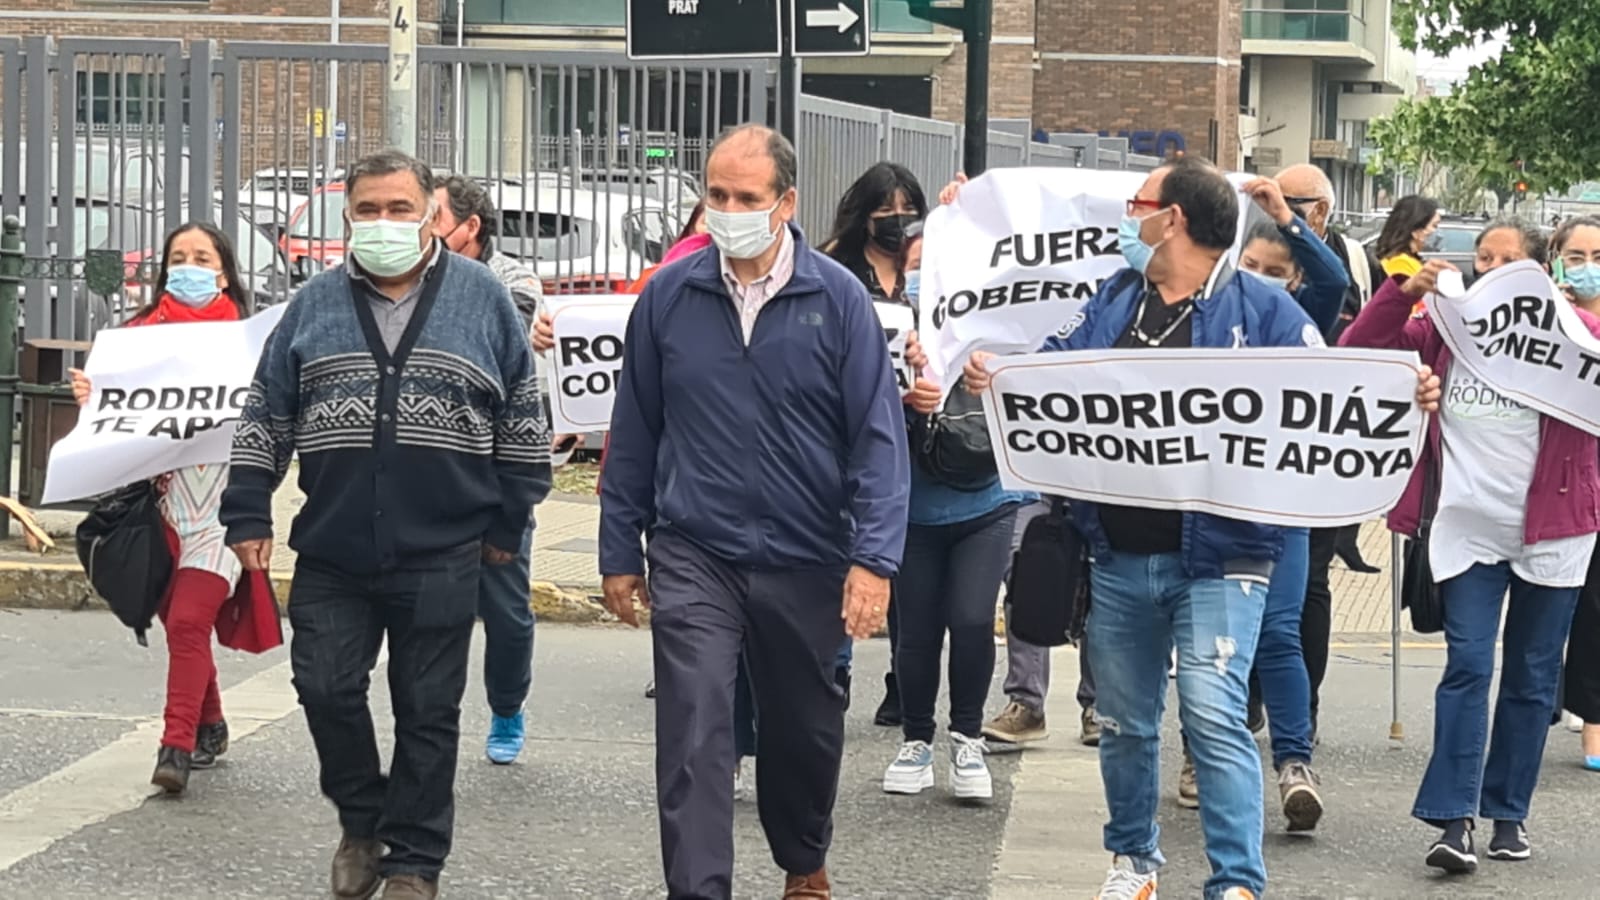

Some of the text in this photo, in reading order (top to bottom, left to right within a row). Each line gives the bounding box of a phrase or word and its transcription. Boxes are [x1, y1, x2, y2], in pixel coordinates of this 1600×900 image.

[393, 5, 409, 33] 4
[668, 0, 699, 15] PRAT
[1577, 352, 1600, 388] T
[147, 416, 242, 440] AP
[1001, 387, 1263, 429] RODRIGO
[1280, 385, 1412, 440] DIÁZ
[1007, 429, 1413, 479] CORONEL TE APOYA
